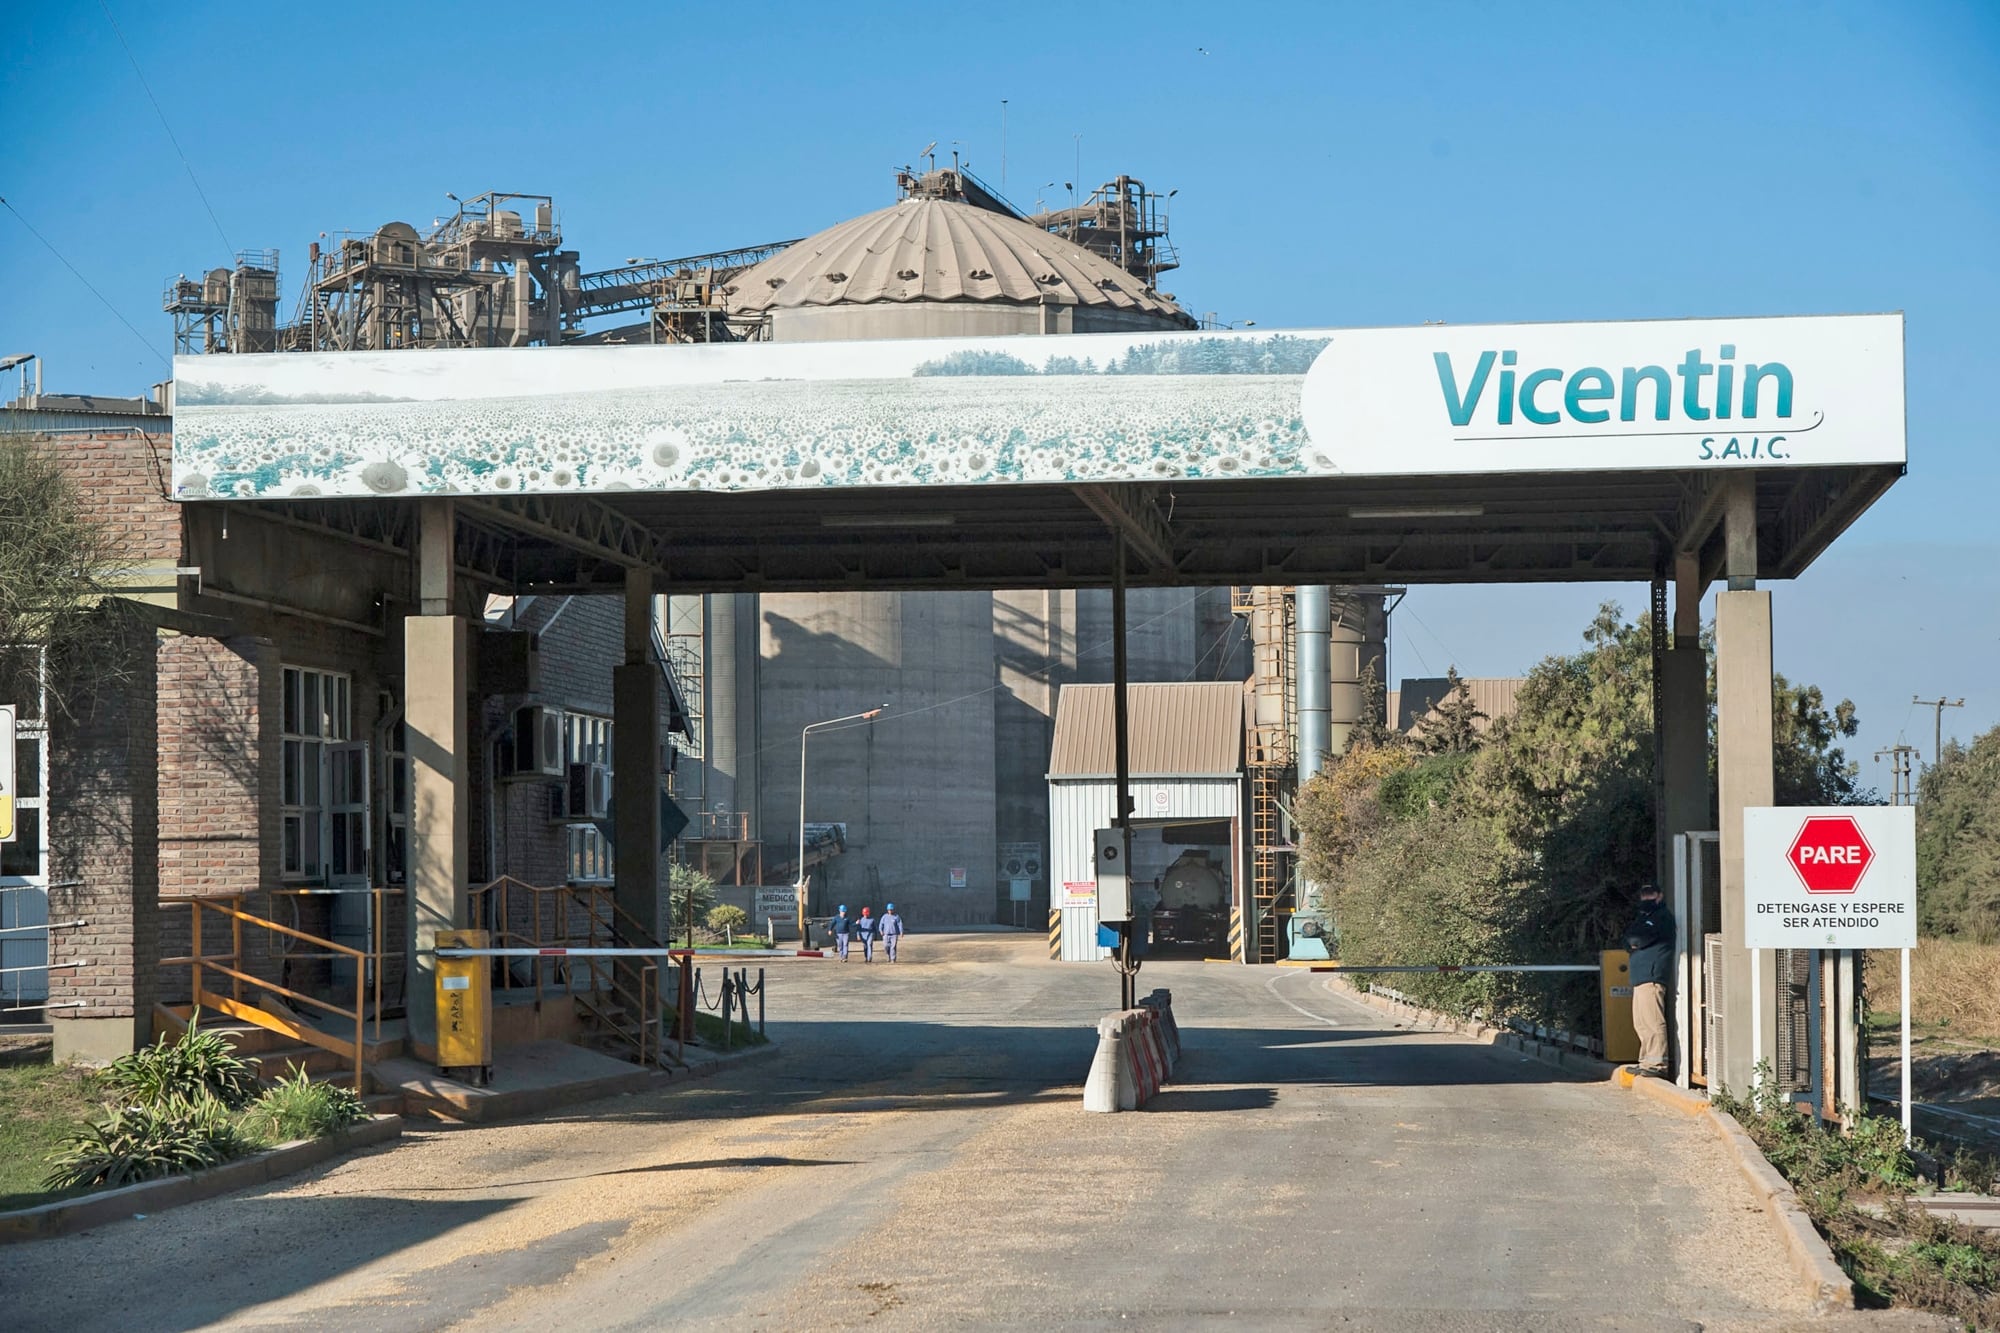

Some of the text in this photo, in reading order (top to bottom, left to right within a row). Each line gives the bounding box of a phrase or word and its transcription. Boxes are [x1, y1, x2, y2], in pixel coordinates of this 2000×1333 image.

[1432, 344, 1795, 426] Vicentin
[1698, 436, 1792, 460] S.A.I.C.
[1800, 845, 1862, 864] PARE
[762, 894, 795, 902] MEDICO
[1757, 903, 1905, 914] DETENGASE Y ESPERE
[1783, 917, 1879, 928] SER ATENDIDO
